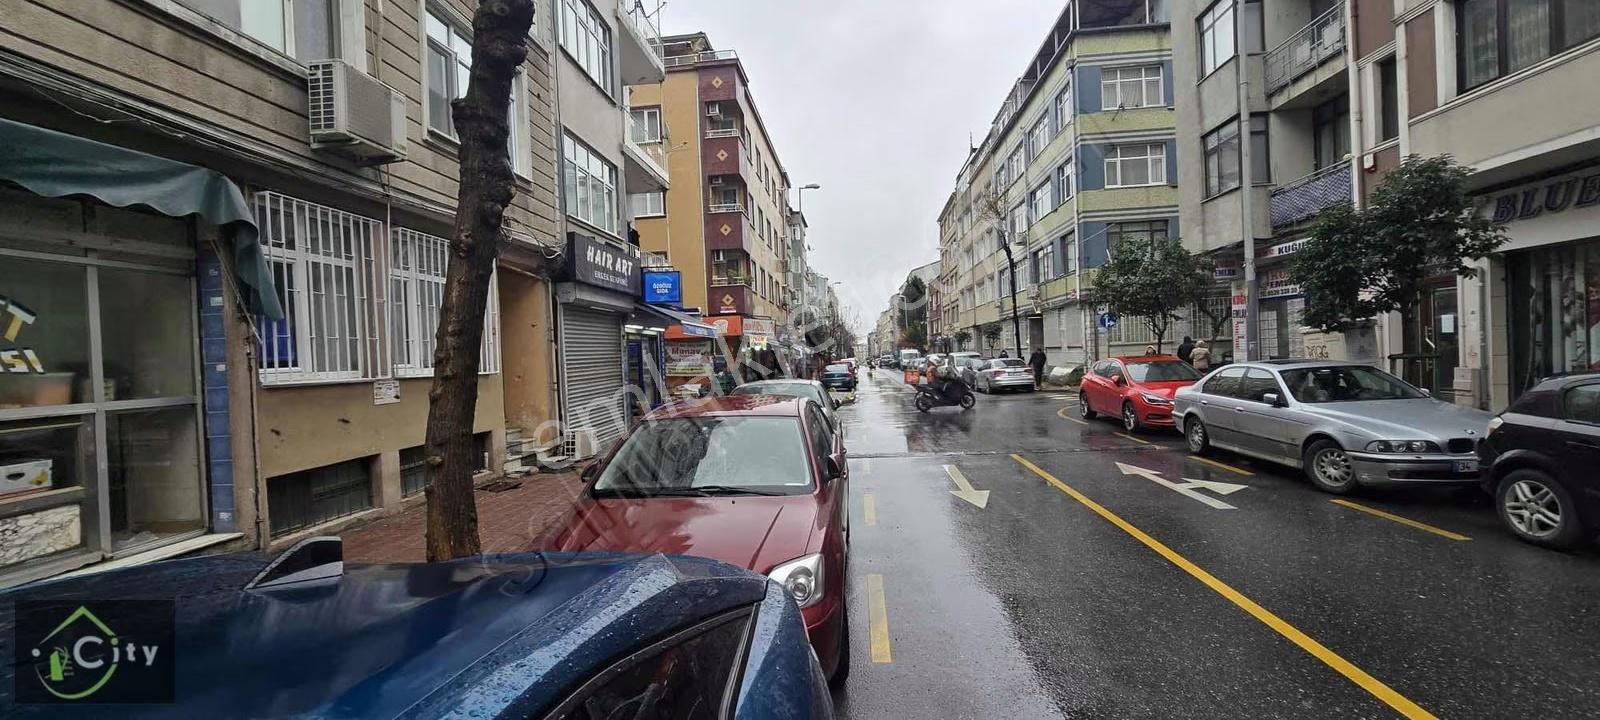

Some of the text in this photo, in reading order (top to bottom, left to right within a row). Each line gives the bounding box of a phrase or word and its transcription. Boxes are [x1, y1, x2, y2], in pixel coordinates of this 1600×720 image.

[1493, 175, 1600, 225] BLUE
[586, 246, 633, 276] HAIR ART
